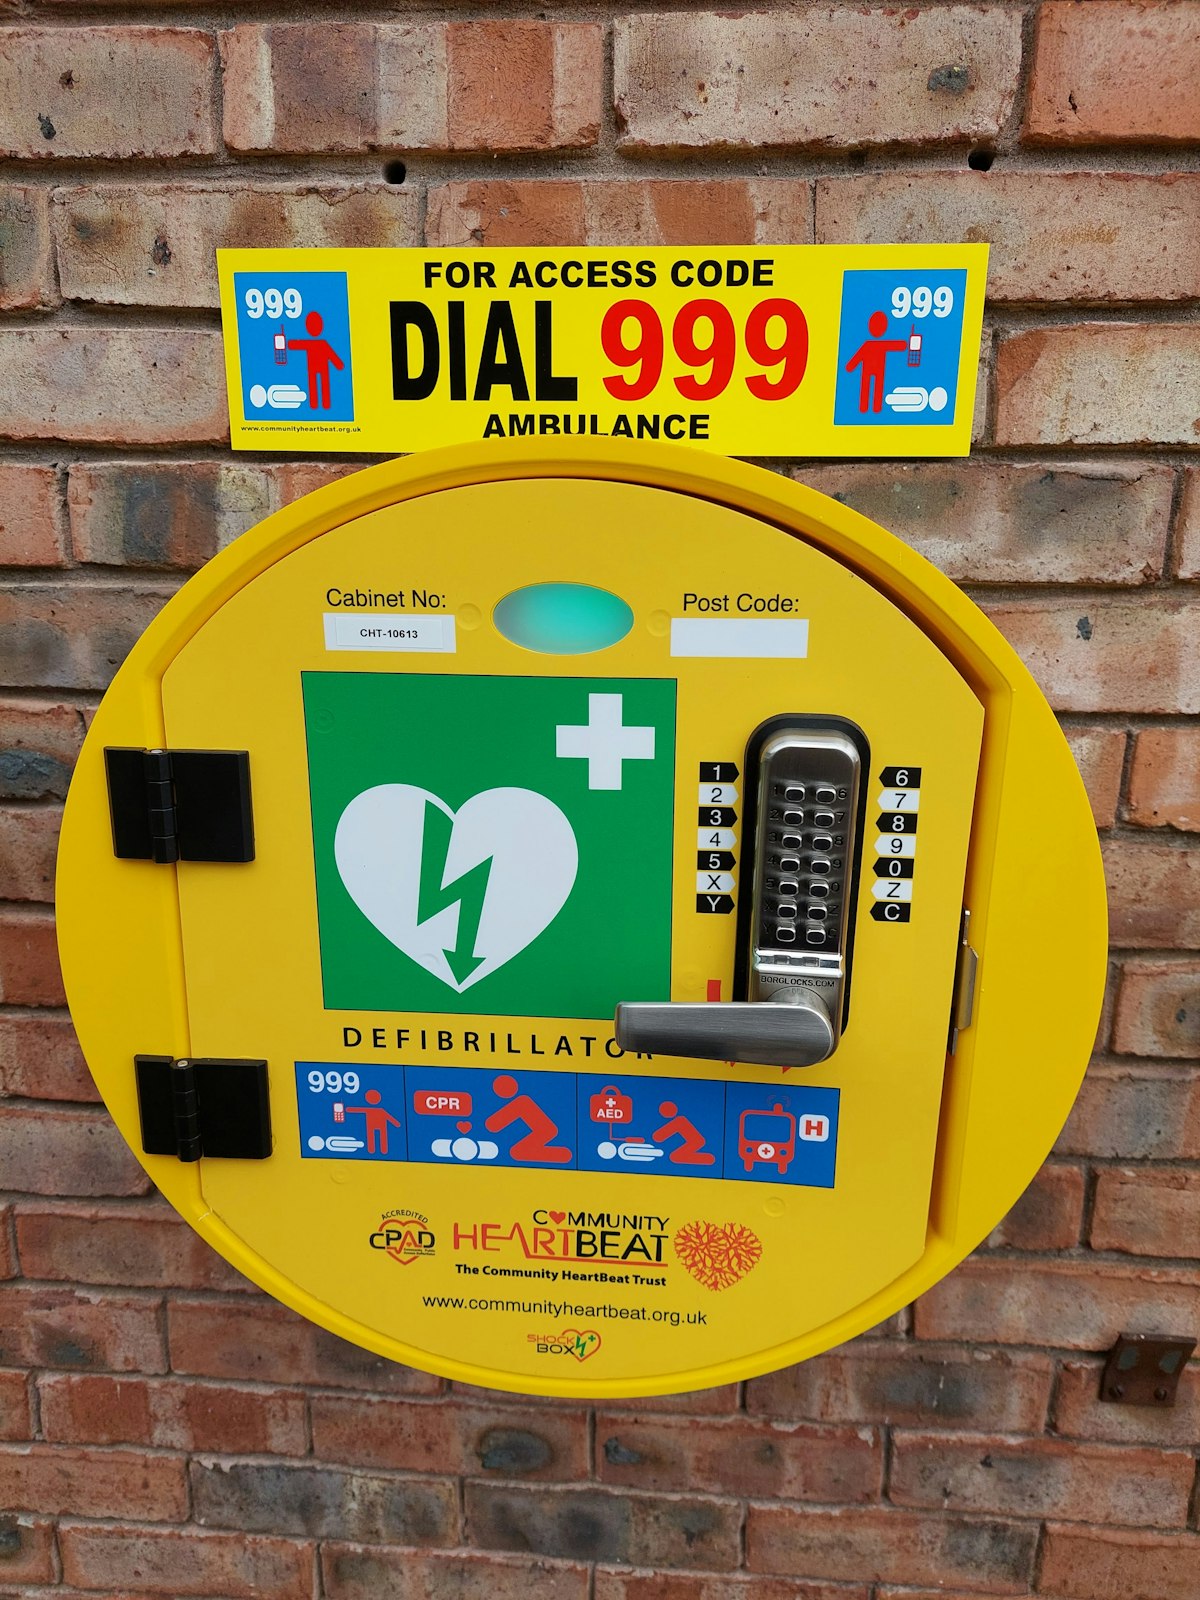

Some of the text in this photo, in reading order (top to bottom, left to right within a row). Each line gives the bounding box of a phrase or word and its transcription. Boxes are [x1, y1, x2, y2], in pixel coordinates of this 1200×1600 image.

[424, 259, 774, 288] FOR ACCESS CODE
[245, 288, 303, 319] 999
[891, 286, 954, 319] 999
[389, 298, 809, 402] DIAL 999
[241, 426, 361, 434] www.communityheartbeat.org.uk
[483, 414, 710, 439] AMBULANCE
[326, 588, 446, 609] Cabinet No:
[683, 593, 799, 613] Post Code:
[359, 628, 418, 639] CHT-10613
[713, 765, 721, 780] 1
[895, 770, 909, 786] 6
[711, 788, 722, 803] 2
[838, 787, 847, 800] 6
[895, 793, 907, 808] 7
[710, 810, 722, 825] 3
[769, 809, 779, 821] 2
[835, 811, 845, 824] 7
[892, 816, 905, 832] 8
[709, 832, 721, 847] 4
[768, 832, 777, 844] 3
[834, 835, 843, 847] 8
[890, 838, 903, 854] 9
[709, 854, 720, 869] 5
[767, 856, 777, 866] 4
[832, 859, 842, 869] 9
[889, 860, 902, 877] 0
[707, 874, 722, 890] X
[766, 879, 775, 889] 5
[831, 882, 840, 892] 0
[887, 882, 901, 898] Z
[706, 896, 721, 912] Y
[828, 905, 838, 916] Z
[884, 904, 900, 921] C
[827, 928, 837, 938] C
[760, 976, 835, 987] BORGLOCKS.COM
[343, 1027, 653, 1060] DEFIBRILLATO
[307, 1070, 360, 1094] 999
[425, 1096, 460, 1110] CPR
[596, 1108, 623, 1119] AED
[804, 1120, 823, 1137] H
[381, 1209, 429, 1224] ACCREDITED
[369, 1229, 436, 1251] CPAD
[455, 1264, 667, 1286] The Community HeartBeat Trust
[422, 1296, 707, 1328] www.communityheartbeat.org.uk
[527, 1334, 575, 1345] SHOCK
[537, 1343, 575, 1356] BOX
